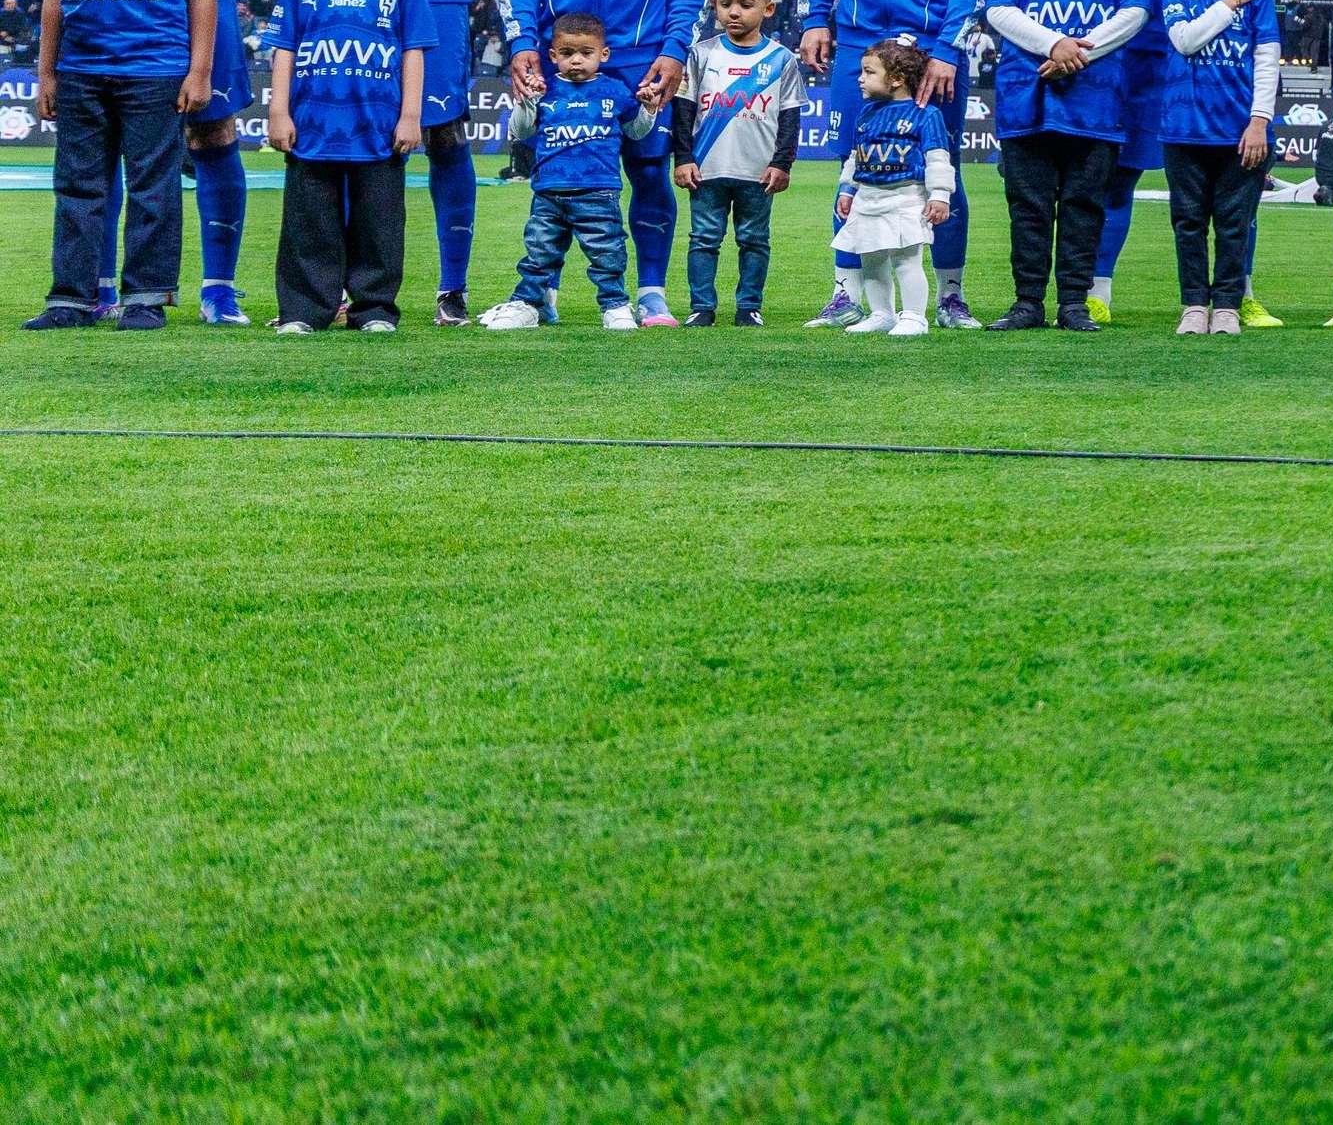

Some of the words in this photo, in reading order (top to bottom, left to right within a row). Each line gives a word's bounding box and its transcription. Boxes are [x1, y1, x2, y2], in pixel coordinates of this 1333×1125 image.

[295, 39, 396, 69] SAVVY
[296, 67, 338, 78] GAMES
[345, 68, 391, 81] GROUP
[701, 90, 772, 114] SAVVY
[545, 124, 612, 143] SAVVY
